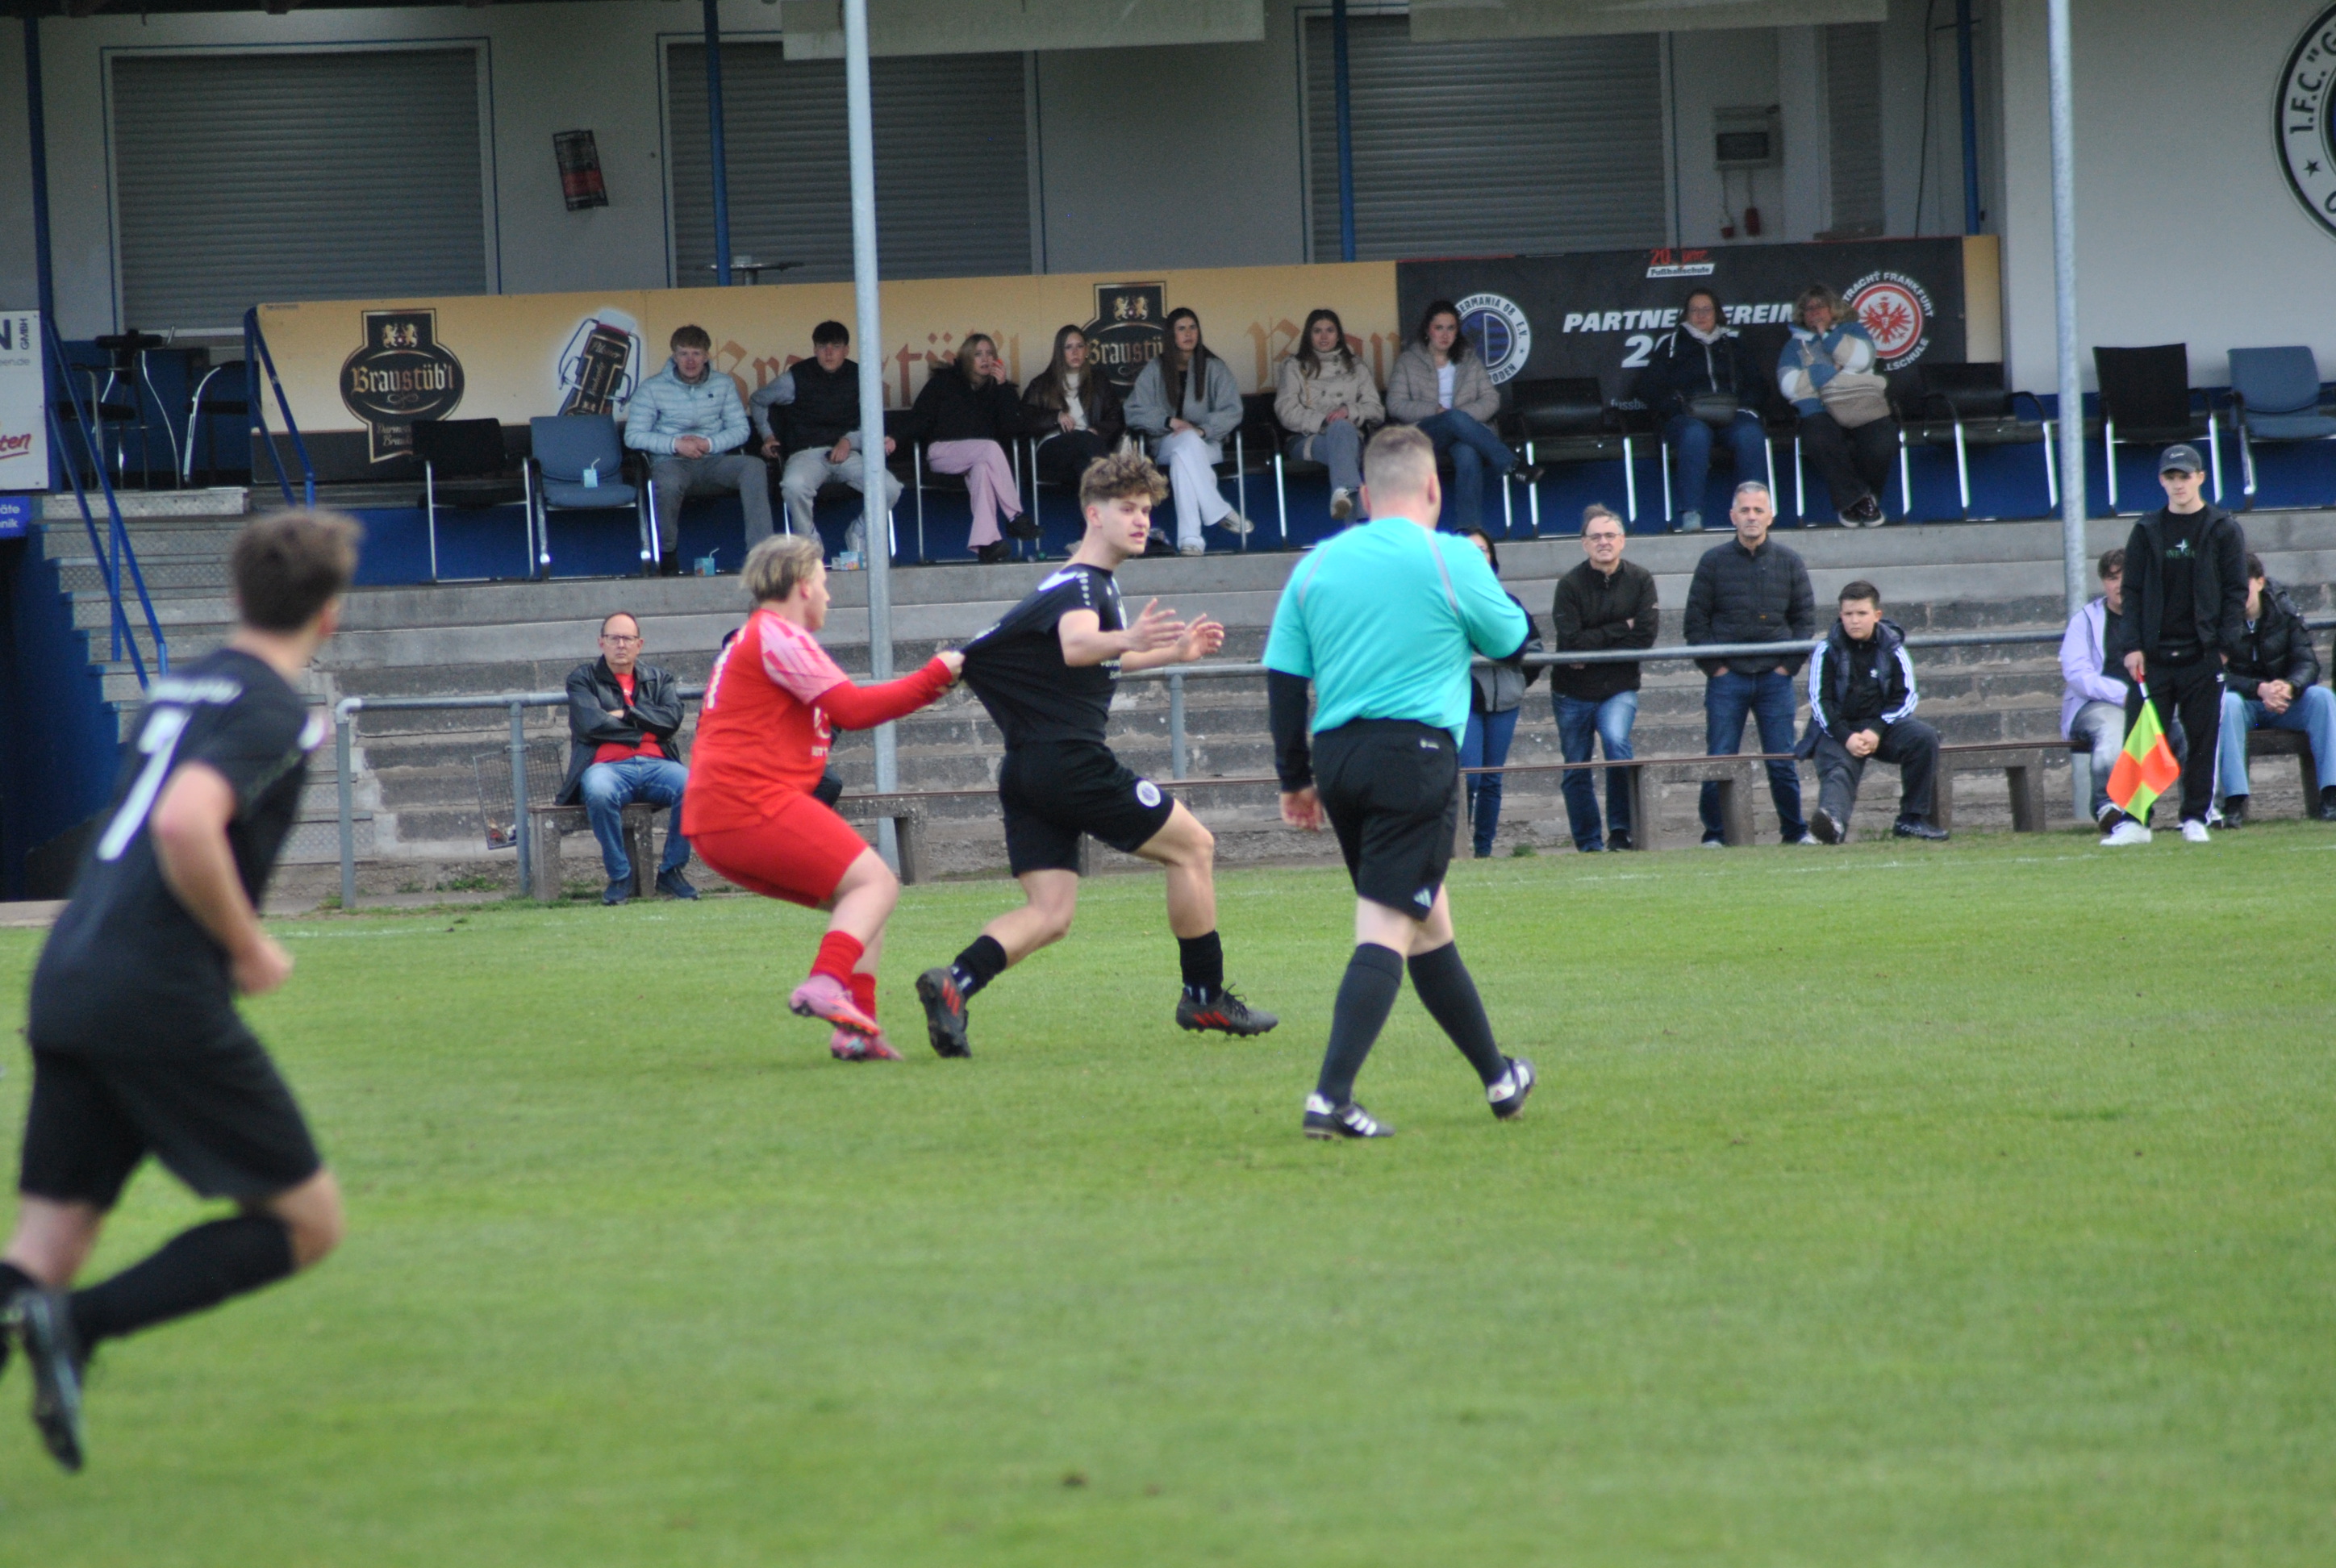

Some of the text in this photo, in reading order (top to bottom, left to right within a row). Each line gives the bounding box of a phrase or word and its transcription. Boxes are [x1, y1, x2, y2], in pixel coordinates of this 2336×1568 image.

[1842, 271, 1933, 318] TRACHT FRANKFURT
[1456, 296, 1501, 315] ERMANIA
[1503, 303, 1516, 316] 08
[1562, 304, 1794, 333] PARTNEEREIN
[1491, 363, 1517, 383] ODEN
[0, 433, 31, 452] ten
[0, 503, 21, 515] äte
[0, 518, 19, 528] nik
